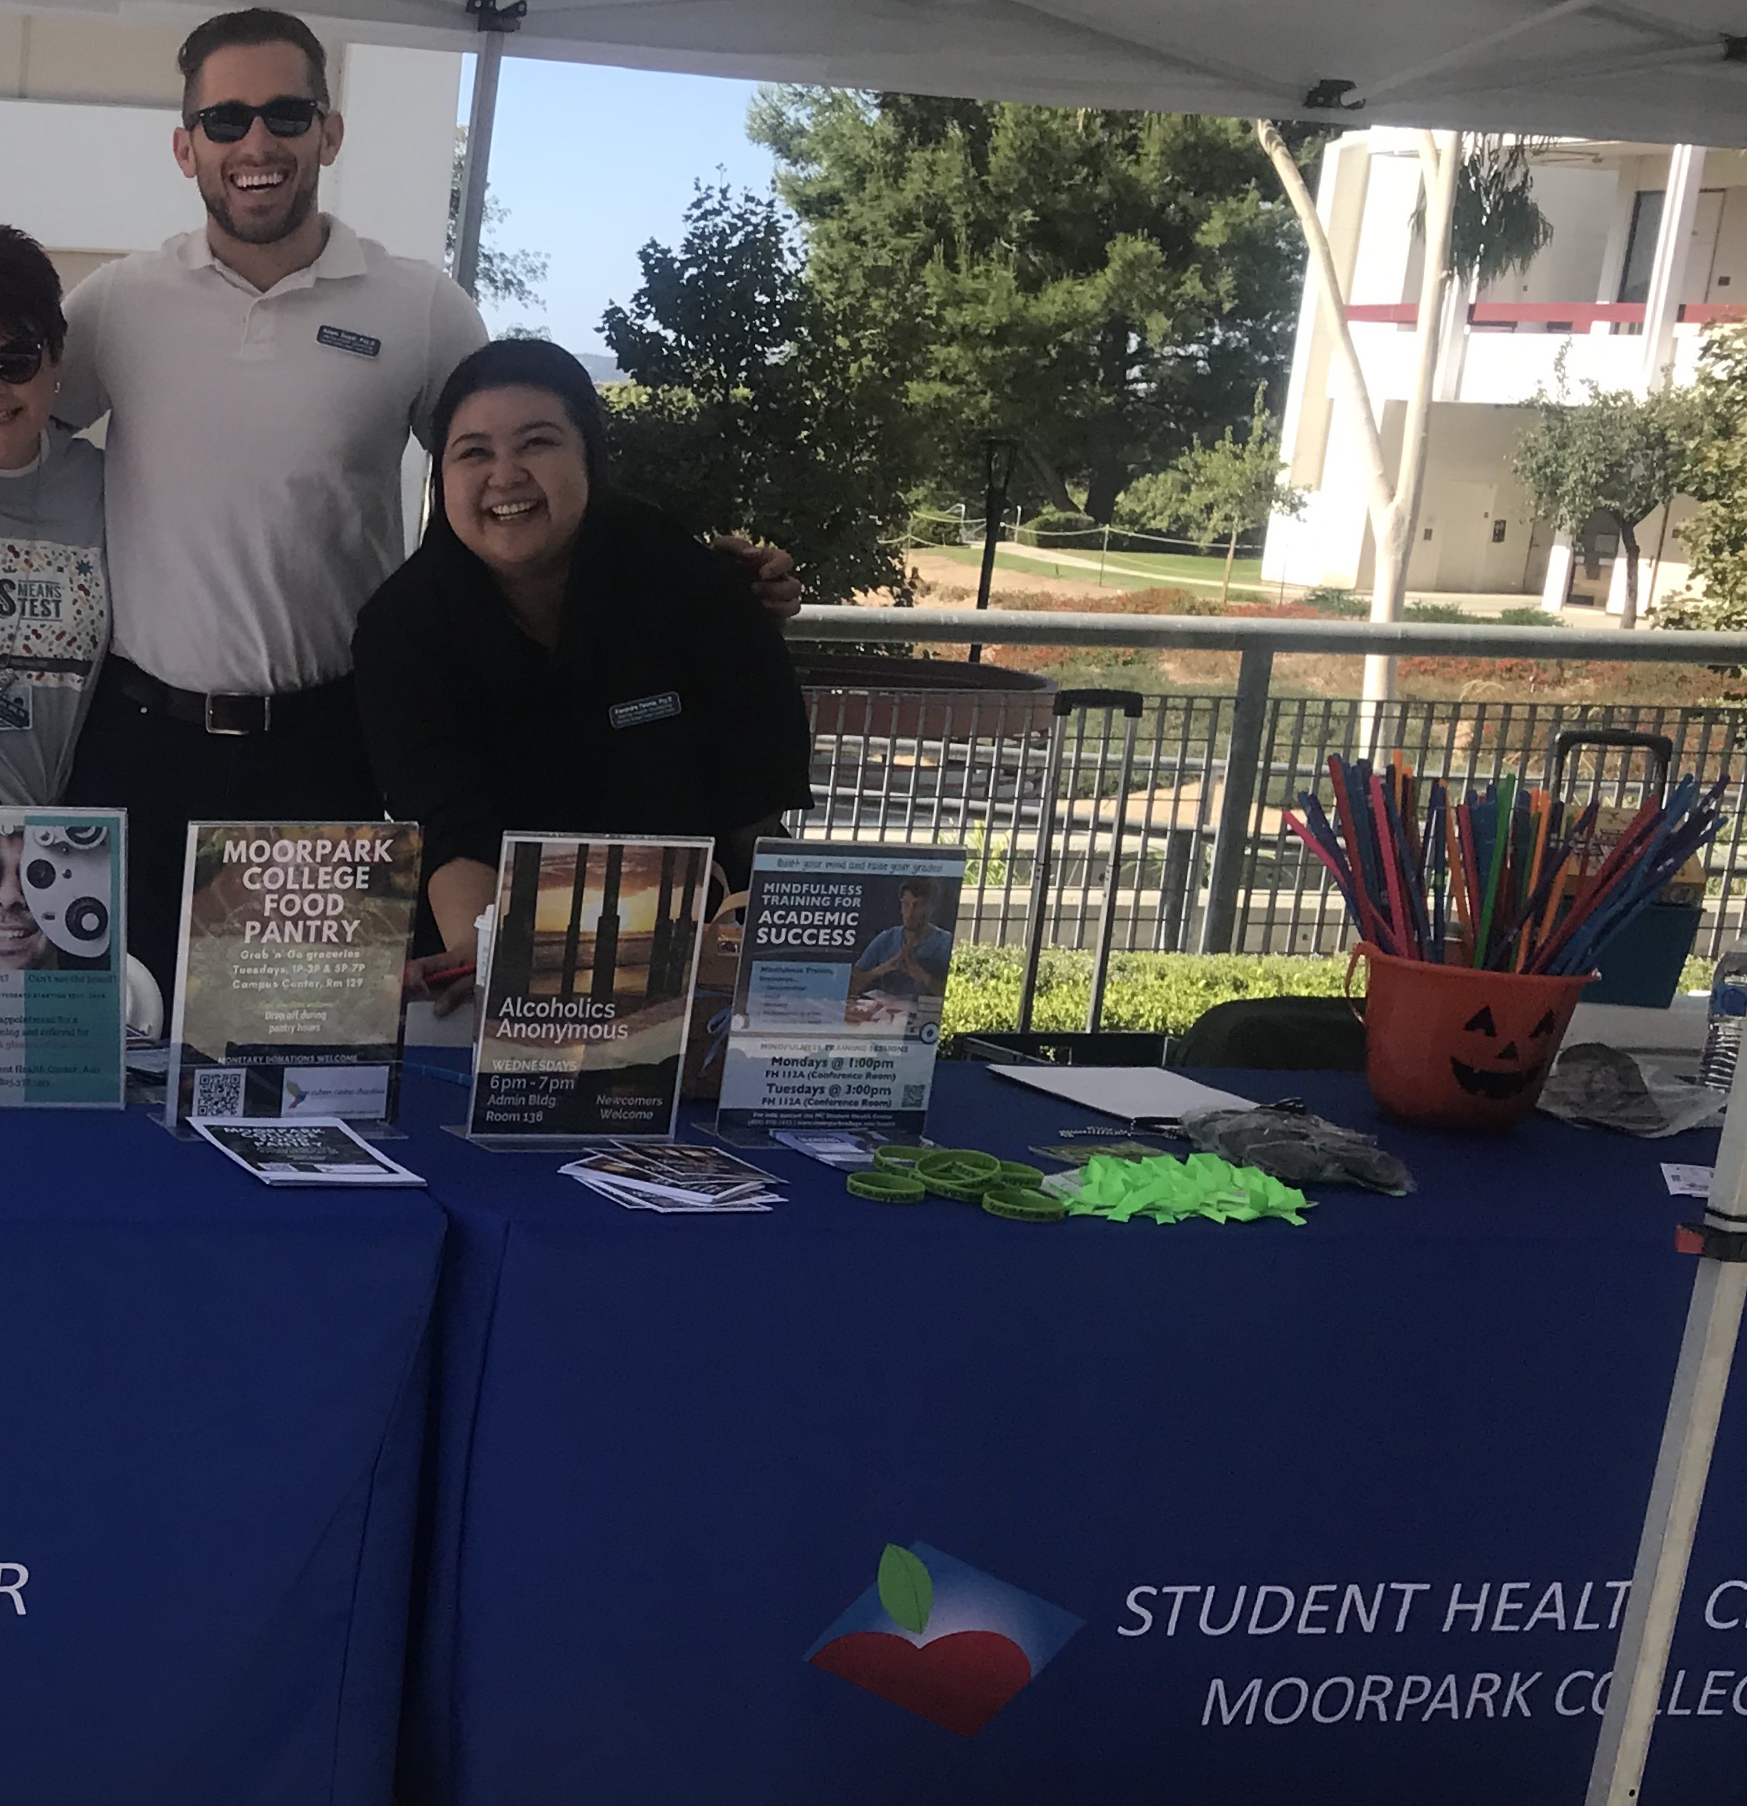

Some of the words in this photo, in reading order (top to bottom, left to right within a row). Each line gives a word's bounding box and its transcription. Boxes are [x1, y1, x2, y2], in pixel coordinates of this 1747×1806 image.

[17, 582, 63, 598] MEANS
[16, 598, 63, 618] TEST
[222, 839, 394, 864] MOORPARK
[242, 866, 370, 890] COLLEGE
[763, 882, 863, 896] MINDFULNESS
[263, 893, 345, 917] FOOD
[762, 895, 831, 907] TRAINING
[834, 896, 861, 908] FOR
[758, 910, 859, 926] ACADEMIC
[244, 919, 361, 944] PANTRY
[756, 927, 857, 946] SUCCESS
[240, 948, 269, 960] Grab
[286, 949, 303, 959] Go
[306, 949, 361, 962] groceries
[232, 978, 278, 991] Campus
[326, 978, 343, 988] Rm
[346, 978, 364, 988] 129
[300, 1008, 327, 1022] during
[498, 997, 616, 1019] Alcoholics
[268, 1023, 296, 1035] pantry
[297, 1023, 321, 1032] hours
[496, 1018, 628, 1044] Anonymous
[218, 1055, 263, 1064] MONETARY
[265, 1054, 315, 1064] DONATIONS
[317, 1054, 358, 1063] WELCOME
[492, 1059, 578, 1072] WEDNESDAYS
[771, 1056, 828, 1069] Mondays
[831, 1058, 844, 1070] @
[848, 1058, 895, 1070] 1:00pm
[765, 1070, 780, 1078] FH
[807, 1070, 863, 1081] (Conference
[865, 1071, 897, 1082] Room)
[766, 1083, 825, 1096] Tuesdays
[829, 1084, 842, 1096] @
[844, 1084, 892, 1096] 3:00pm
[487, 1094, 526, 1106] Admin
[596, 1094, 663, 1107] Newcomers
[762, 1097, 777, 1106] FH
[803, 1097, 859, 1107] (Conference
[861, 1098, 892, 1108] Room)
[485, 1110, 521, 1122] Room
[522, 1110, 544, 1123] 138
[600, 1108, 654, 1121] Welcome
[1117, 1581, 1431, 1637] STUDENT
[1441, 1580, 1633, 1633] HEALT
[1200, 1671, 1543, 1727] MOORPARK
